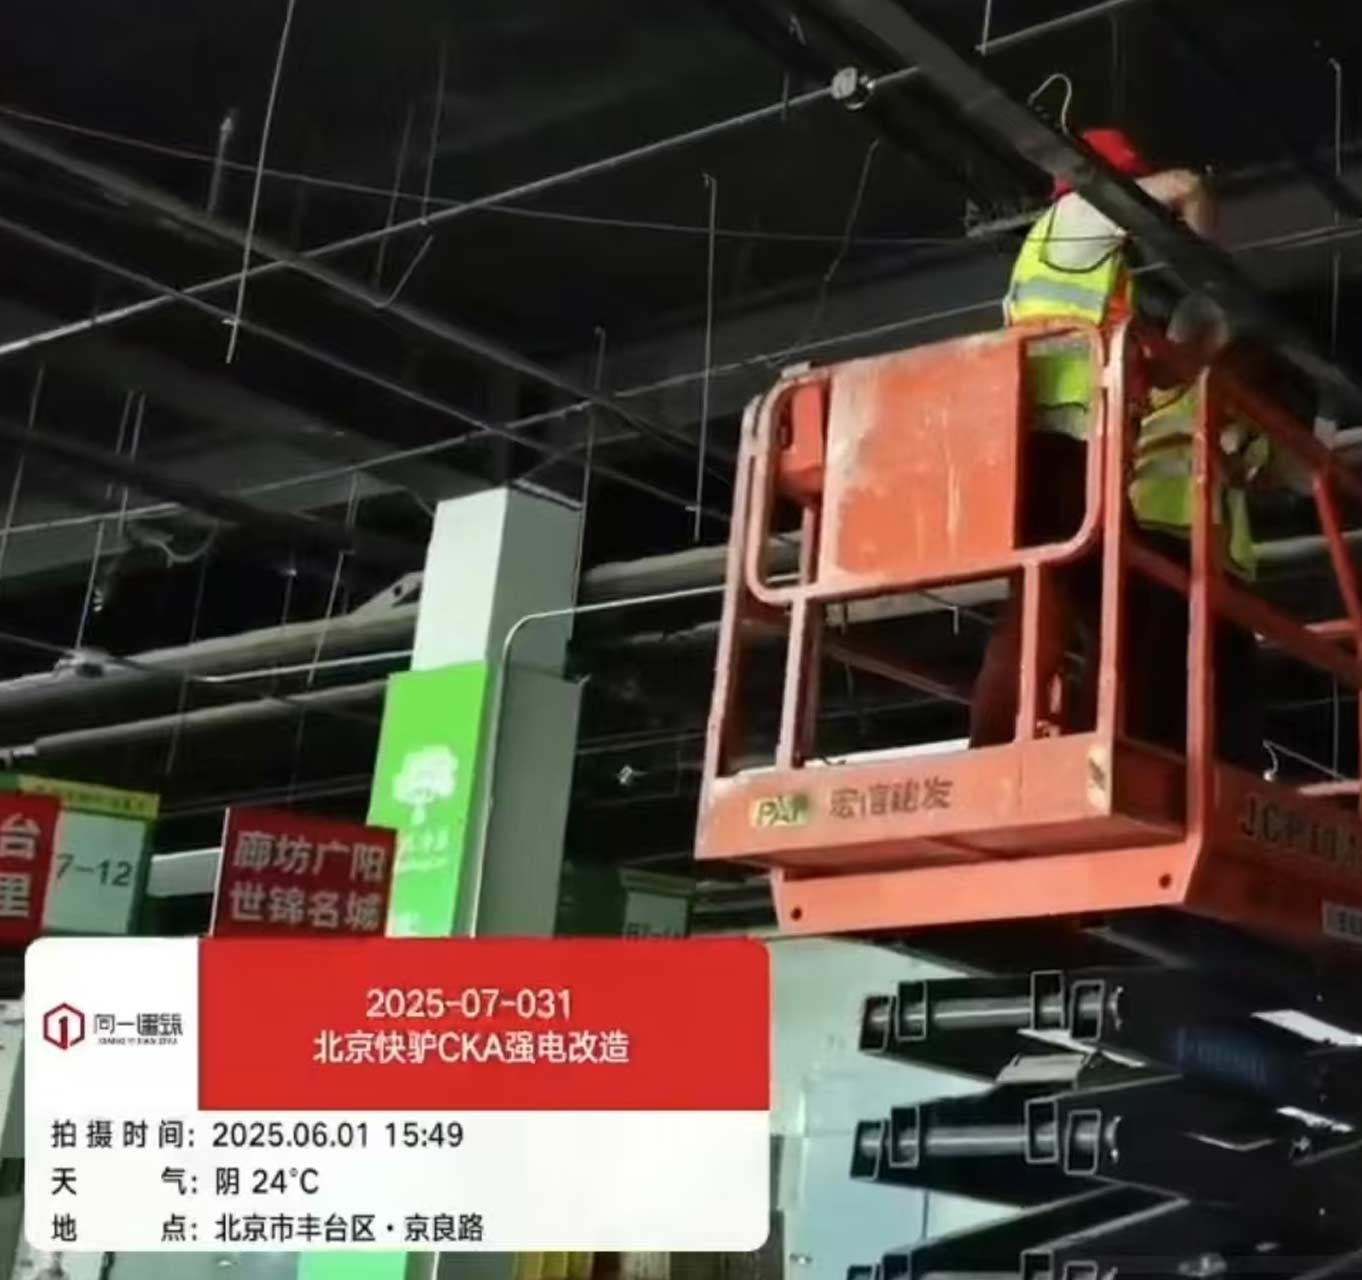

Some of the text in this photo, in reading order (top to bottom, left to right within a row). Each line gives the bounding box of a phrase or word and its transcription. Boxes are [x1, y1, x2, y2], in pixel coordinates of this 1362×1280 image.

[233, 829, 387, 883] 廊坊广阳
[230, 880, 383, 932] 世锦名城
